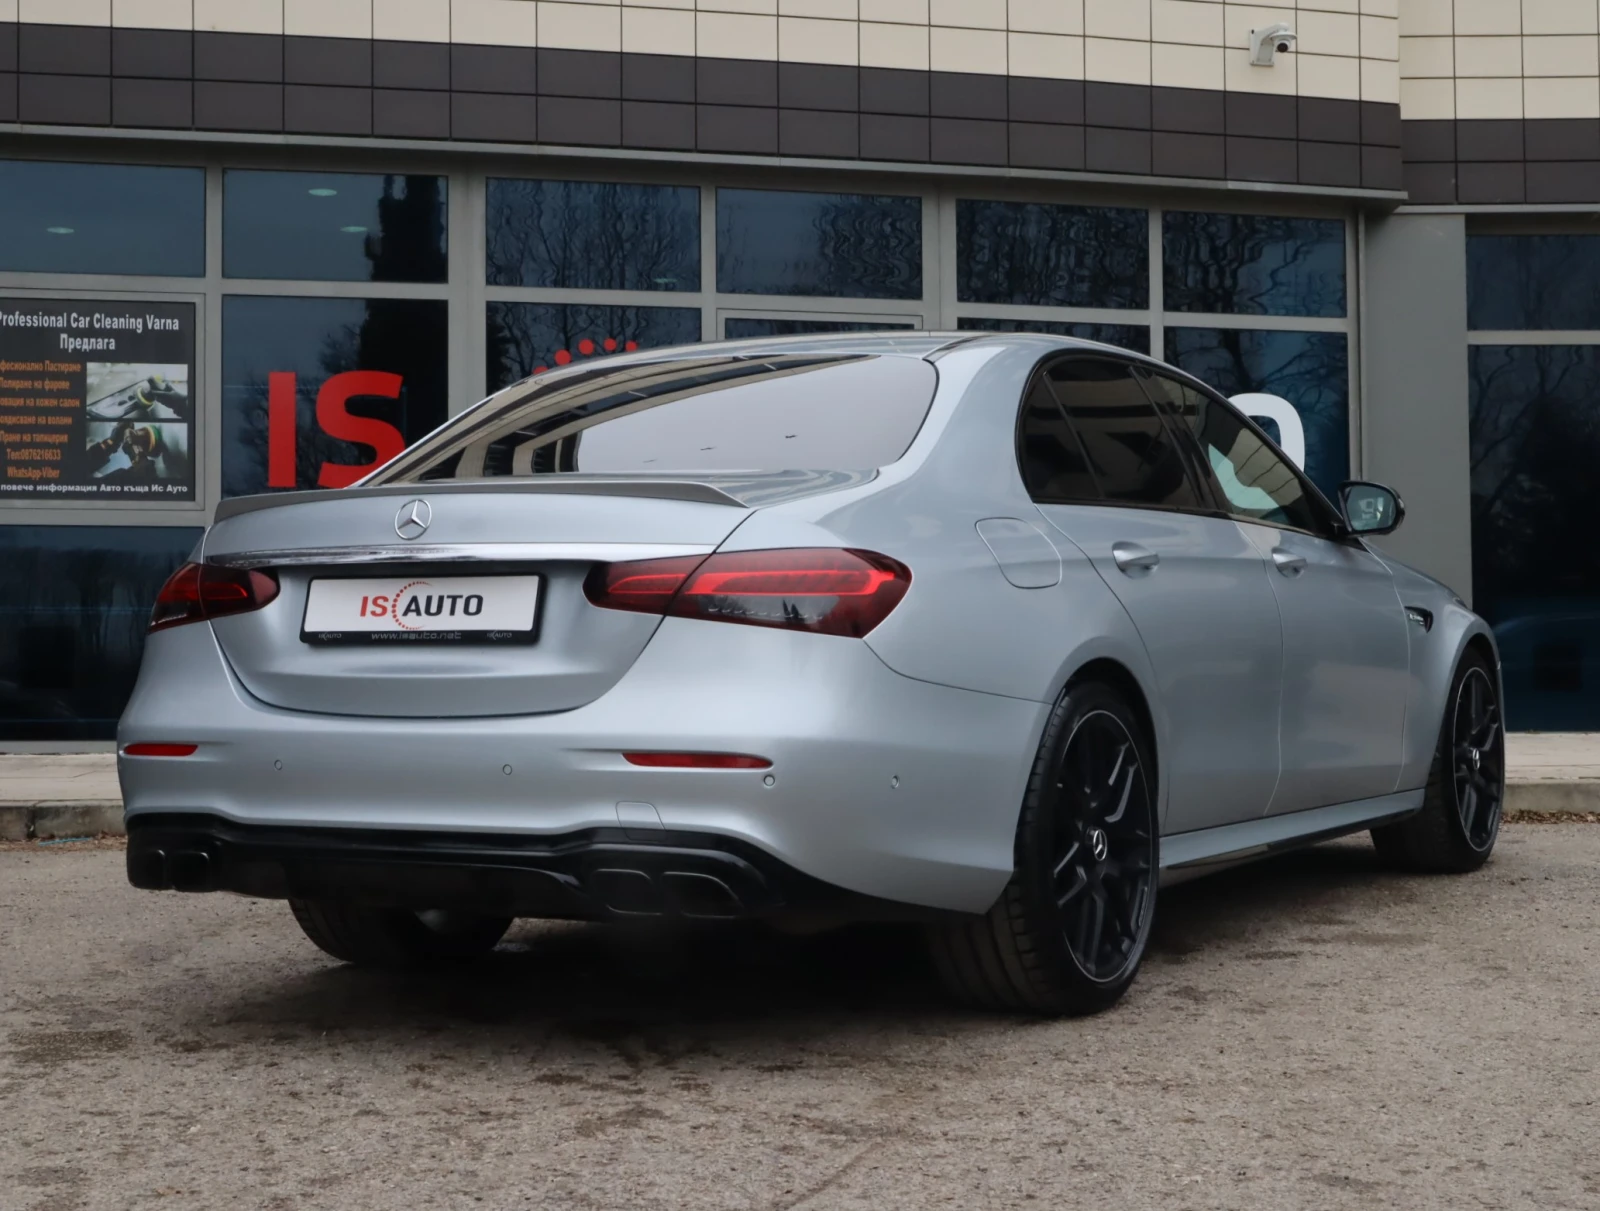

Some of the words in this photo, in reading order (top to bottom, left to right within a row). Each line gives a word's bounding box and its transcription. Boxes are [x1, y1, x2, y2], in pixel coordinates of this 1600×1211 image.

[70, 312, 90, 328] Car
[93, 312, 143, 333] Cleaning
[146, 314, 179, 330] Varna
[60, 333, 116, 352] Предлага
[33, 380, 43, 389] на
[25, 398, 35, 407] на
[60, 399, 80, 408] салон
[37, 416, 47, 425] на
[268, 370, 406, 488] IS
[22, 433, 32, 442] на
[36, 483, 97, 493] информация
[100, 484, 121, 492] Авто
[123, 484, 149, 493] къща
[151, 484, 164, 492] Ис
[166, 484, 188, 494] Ауто
[360, 596, 389, 617] IS
[402, 595, 483, 617] AUTO
